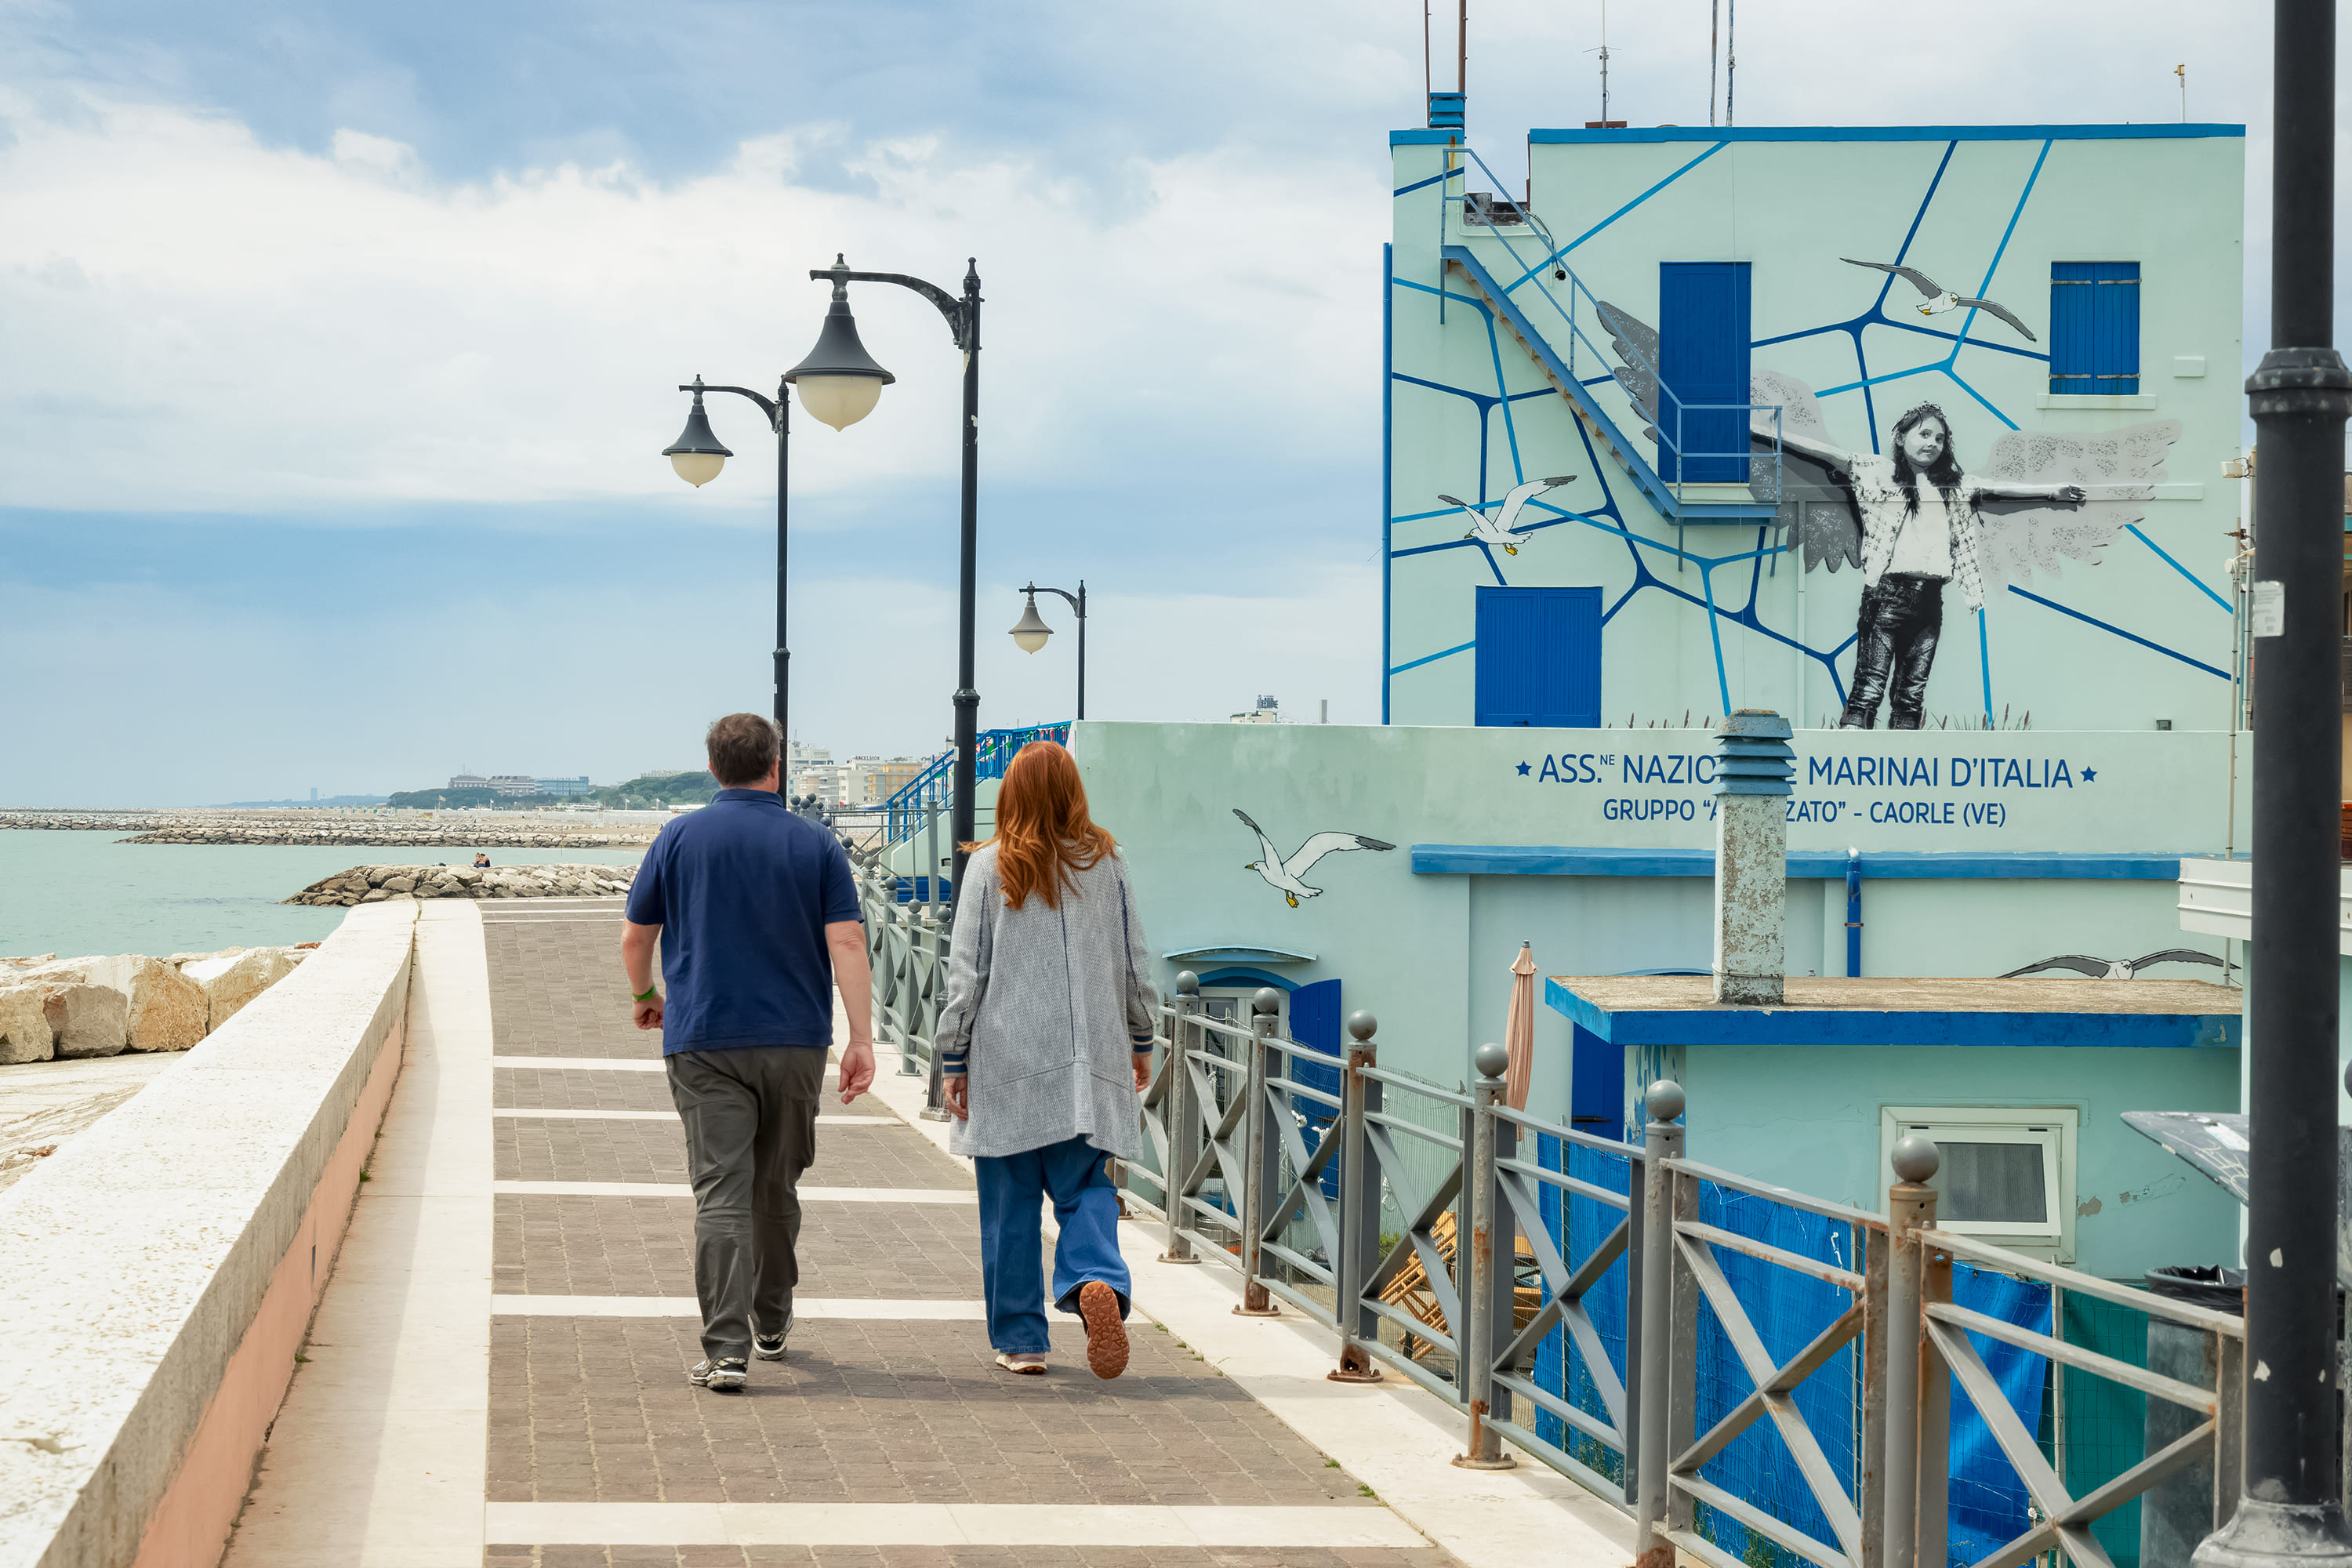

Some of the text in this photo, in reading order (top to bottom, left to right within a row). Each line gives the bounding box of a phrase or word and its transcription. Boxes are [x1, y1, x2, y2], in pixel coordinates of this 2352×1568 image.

[1809, 756, 1938, 786] MARINAI
[1951, 757, 2074, 789] D’ITALIA
[1603, 798, 1695, 821] GRUPPO
[1870, 801, 1955, 824] CAORLE
[1963, 802, 2006, 828] (VE)
